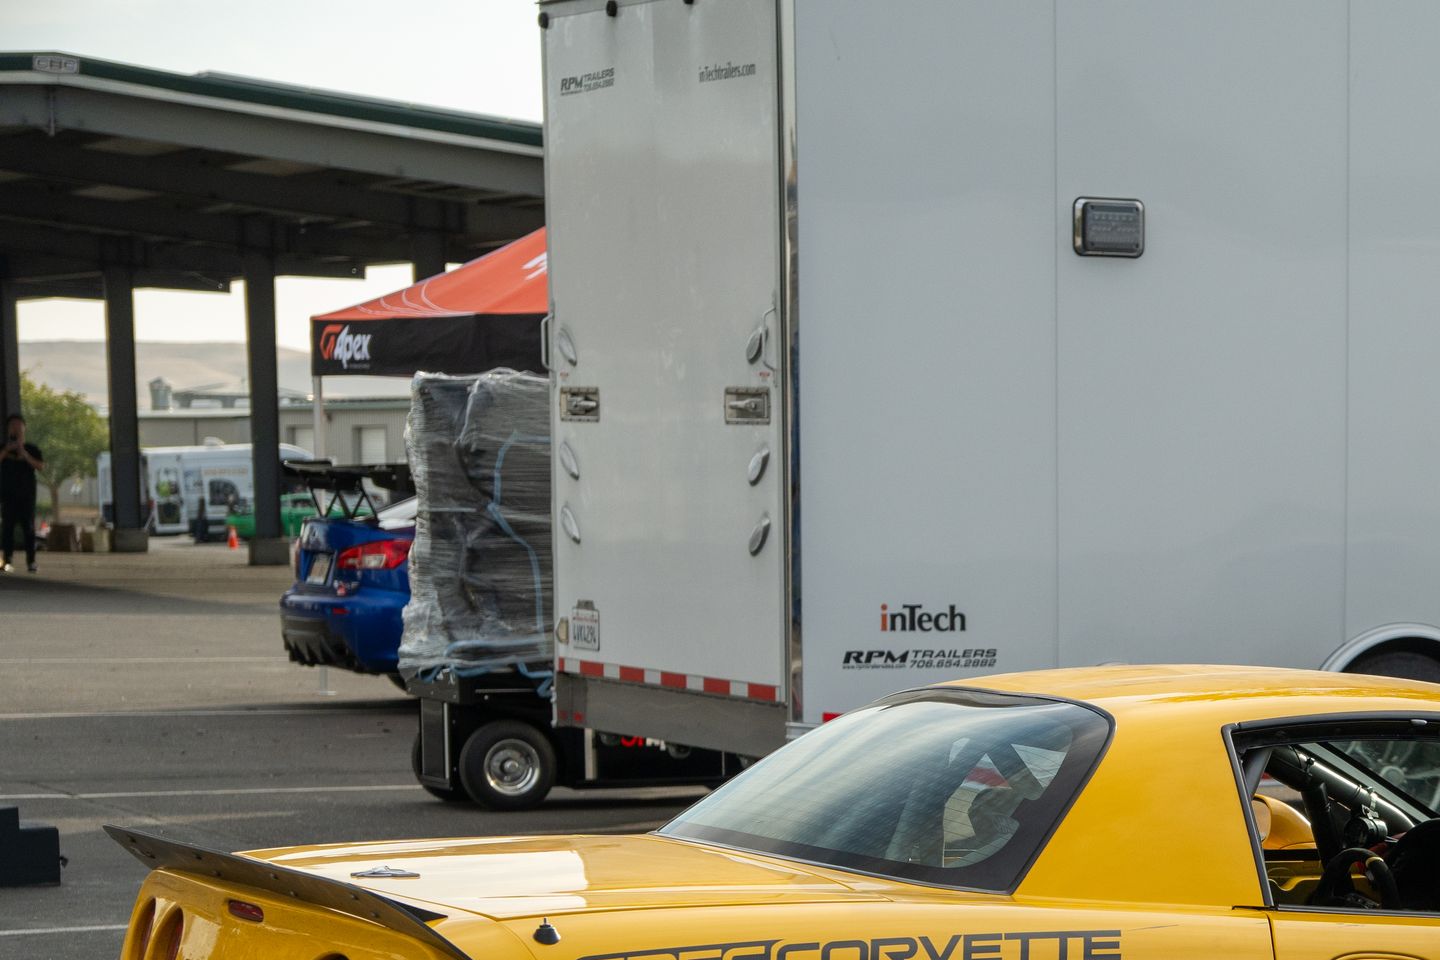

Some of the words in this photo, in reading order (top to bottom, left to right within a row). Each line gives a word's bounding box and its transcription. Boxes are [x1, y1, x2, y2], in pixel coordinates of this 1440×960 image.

[561, 76, 584, 91] RPM
[334, 323, 371, 369] Apex
[880, 603, 966, 632] inTech
[843, 650, 909, 664] RPM
[911, 649, 997, 659] TRAILERS
